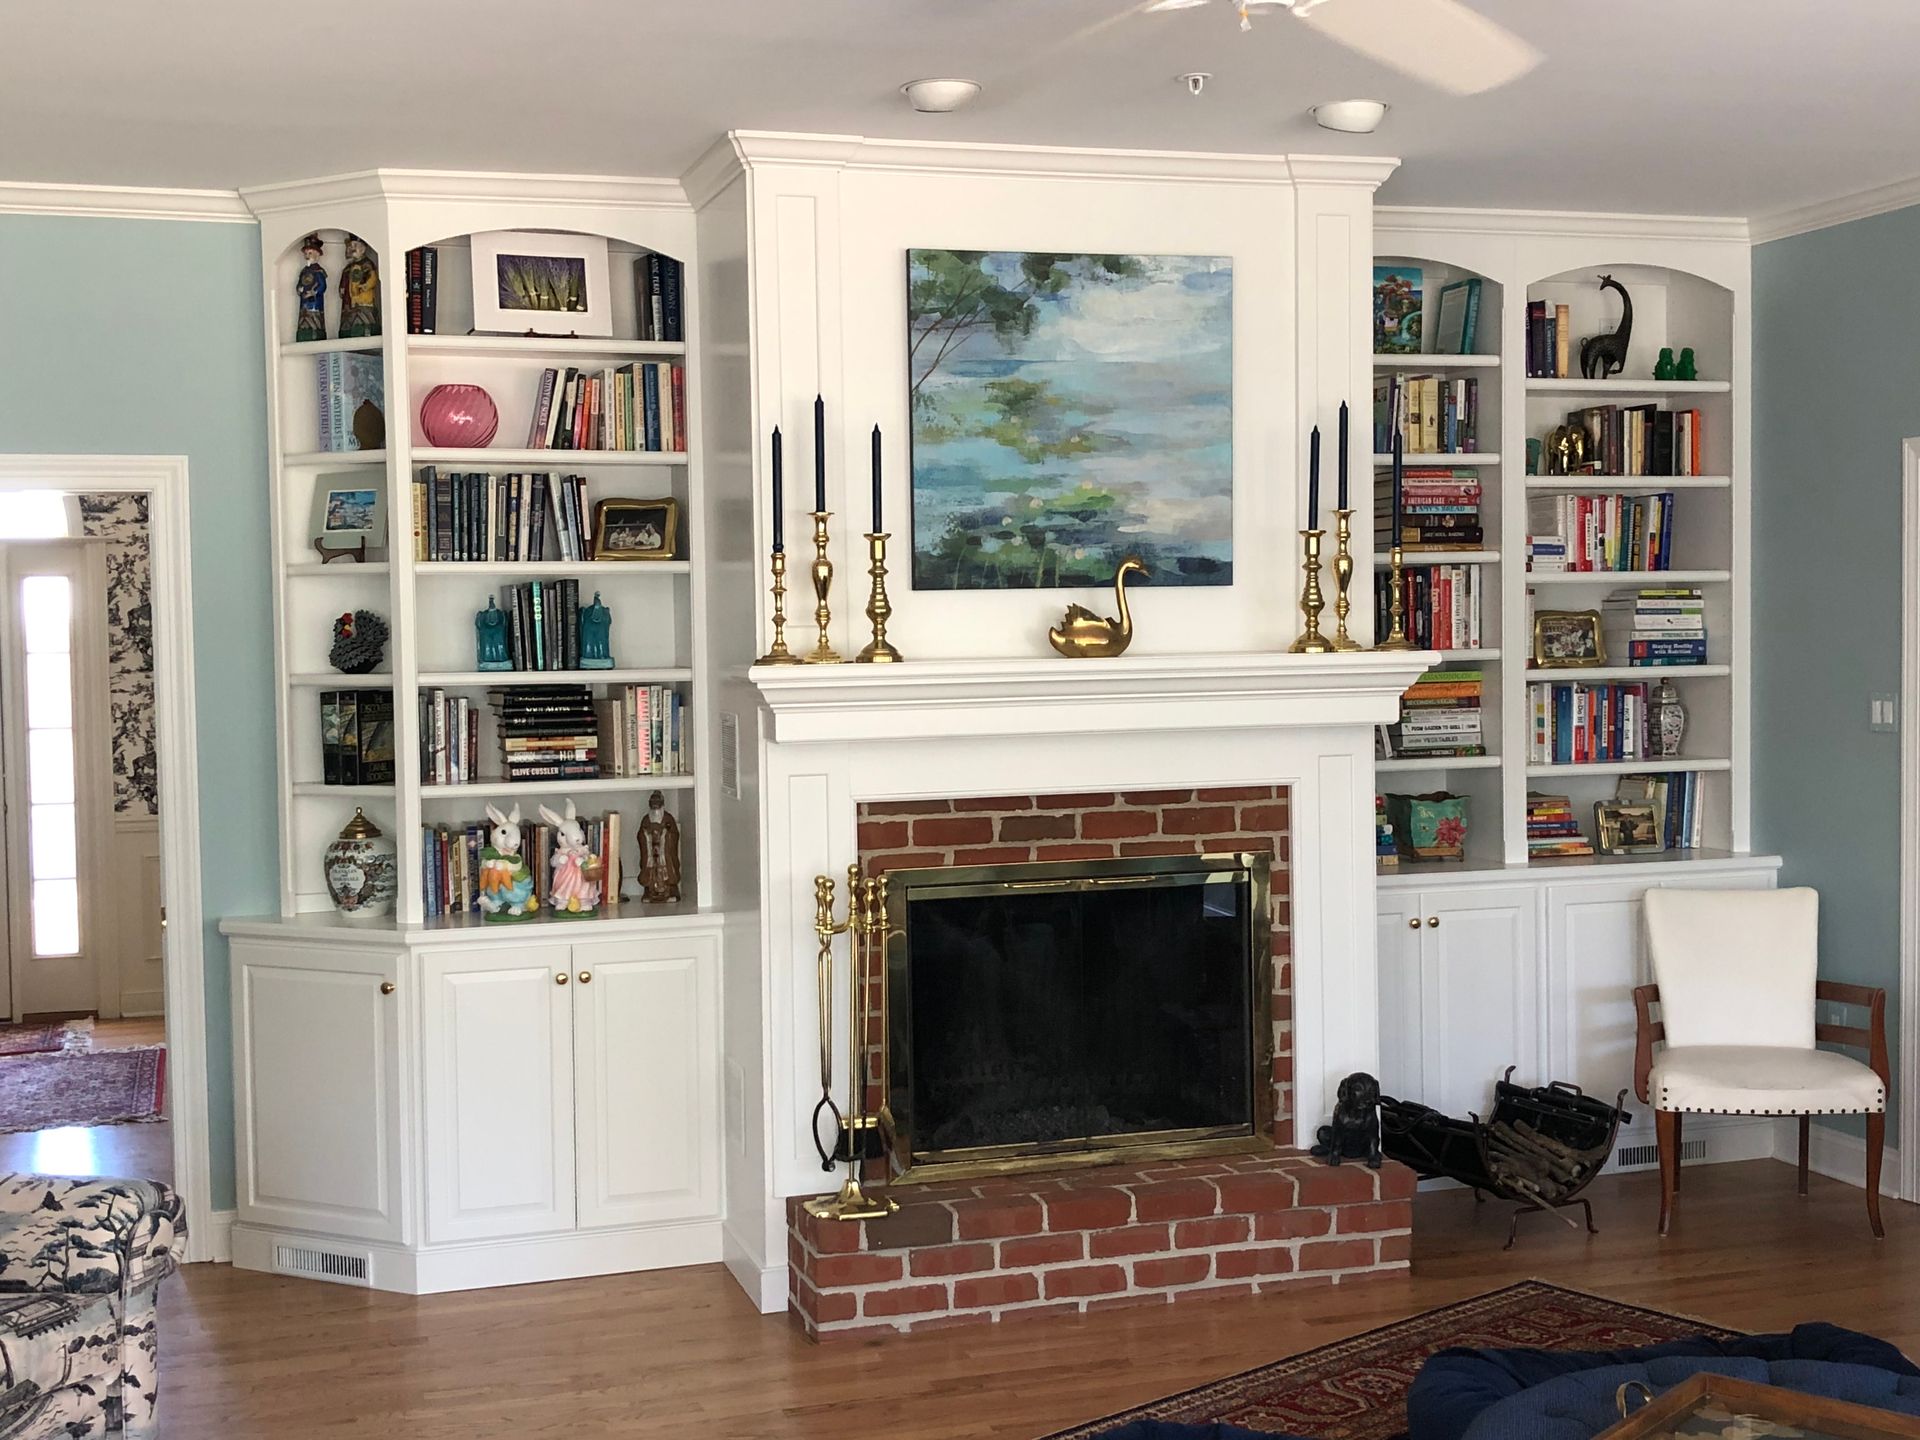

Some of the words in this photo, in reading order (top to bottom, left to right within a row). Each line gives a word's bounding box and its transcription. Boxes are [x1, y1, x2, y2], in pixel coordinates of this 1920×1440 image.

[319, 359, 328, 392] EASTERN
[332, 358, 341, 392] WESTERN
[542, 370, 554, 396] DESTINY
[320, 394, 329, 434] MYSTERIES
[333, 395, 342, 434] MYSTERIES
[538, 406, 548, 426] SOULS
[534, 597, 542, 620] GOD
[1432, 588, 1440, 613] fresh
[1454, 578, 1462, 617] Vegetarian
[1423, 736, 1458, 744] VEGETABLES
[512, 767, 530, 776] CLIVE
[531, 766, 559, 775] CUSSLER
